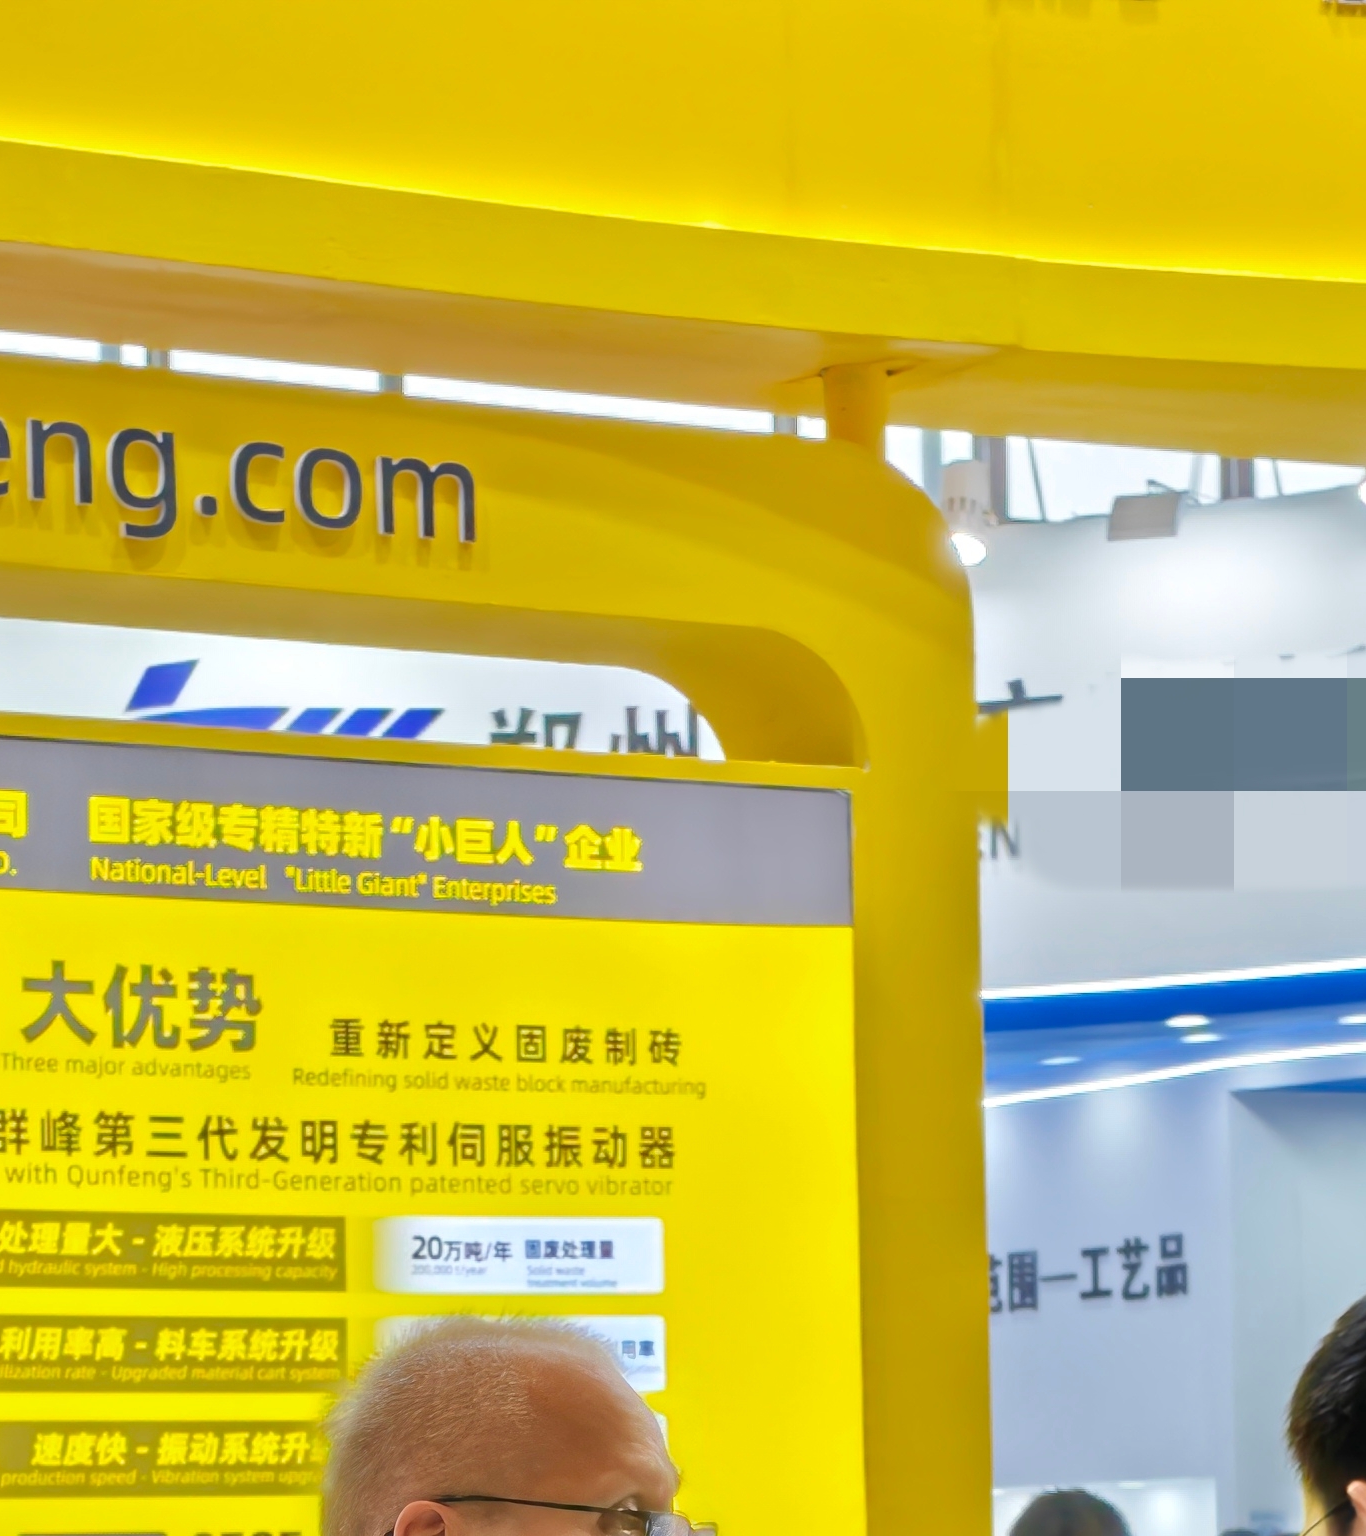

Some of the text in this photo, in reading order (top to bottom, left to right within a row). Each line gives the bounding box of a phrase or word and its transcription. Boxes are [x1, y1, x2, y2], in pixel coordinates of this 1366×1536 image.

[89, 856, 268, 890] National-Level
[432, 876, 557, 906] Enterprises
[328, 1017, 684, 1067] 重新定义固废制砖
[0, 1051, 253, 1082] Three major advantages
[292, 1066, 707, 1100] Redefining solid waste block manufacturing
[4, 1160, 56, 1184] with
[66, 1163, 191, 1194] Qunfeng's
[200, 1167, 404, 1194] Third-Generation
[410, 1171, 513, 1197] patented
[519, 1177, 580, 1196] servo
[586, 1174, 674, 1198] vibrator
[152, 1224, 337, 1260] 液压系统升级
[8, 1259, 81, 1277] hydraulic
[84, 1262, 137, 1278] system
[152, 1261, 188, 1278] High
[191, 1263, 272, 1281] processing
[275, 1265, 338, 1281] capacity
[154, 1327, 339, 1363] 料车系统升级
[64, 1365, 97, 1380] rate
[111, 1364, 188, 1382] Upgraded
[191, 1364, 254, 1380] material
[31, 1431, 127, 1466] 速度快
[1, 1470, 86, 1489] production
[89, 1469, 137, 1488] speed
[152, 1469, 220, 1484] Vibration
